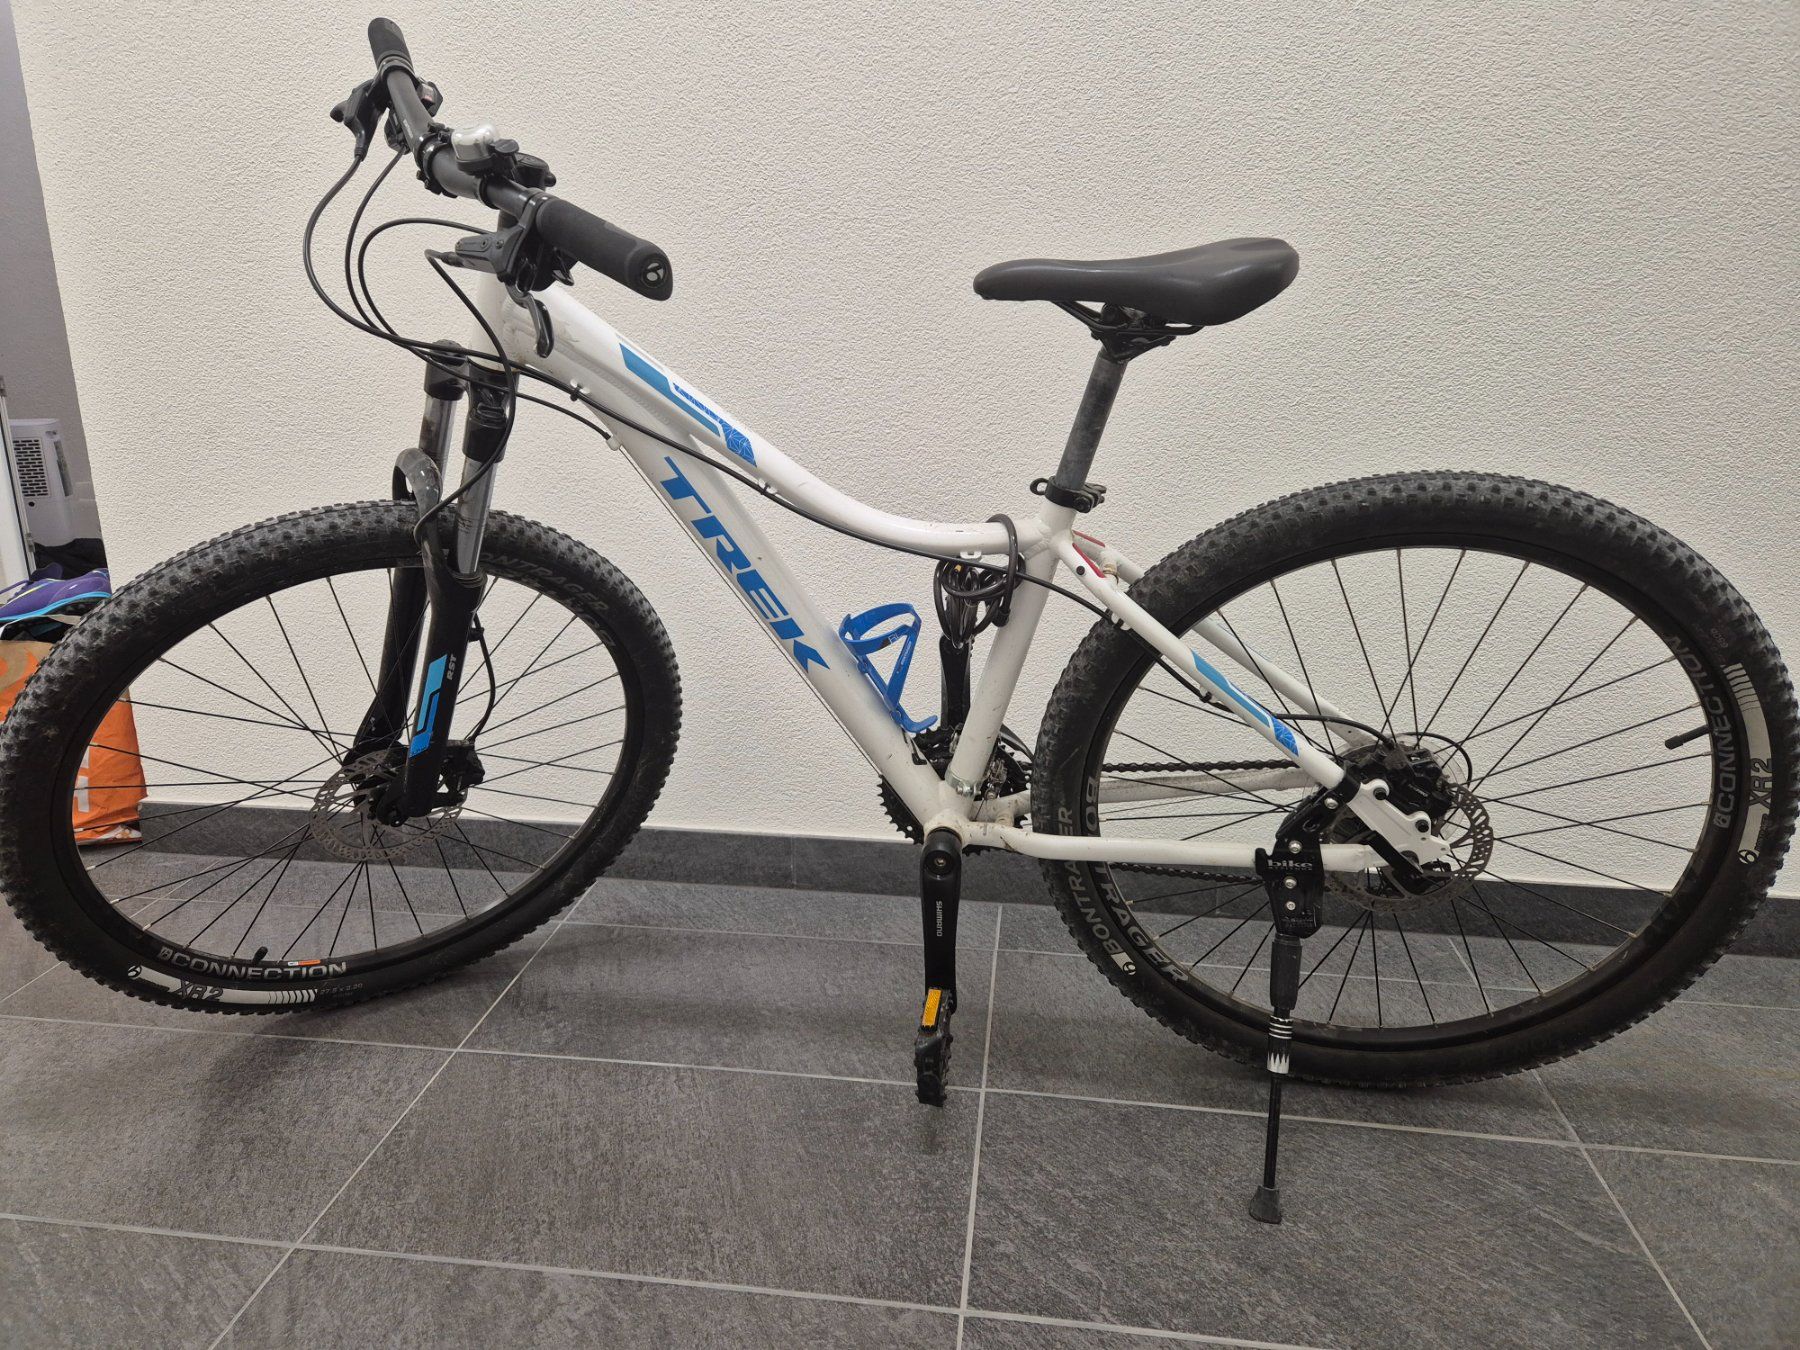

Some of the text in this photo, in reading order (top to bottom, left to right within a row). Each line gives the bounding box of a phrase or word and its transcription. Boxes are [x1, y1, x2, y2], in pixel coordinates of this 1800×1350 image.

[479, 551, 609, 611] ONTRAGER
[660, 455, 831, 674] TREK
[446, 653, 457, 681] RST
[1749, 757, 1773, 810] XR2
[1057, 805, 1124, 955] BONTRAER
[1085, 775, 1190, 982] BOTRAGER
[172, 979, 224, 1002] XR2
